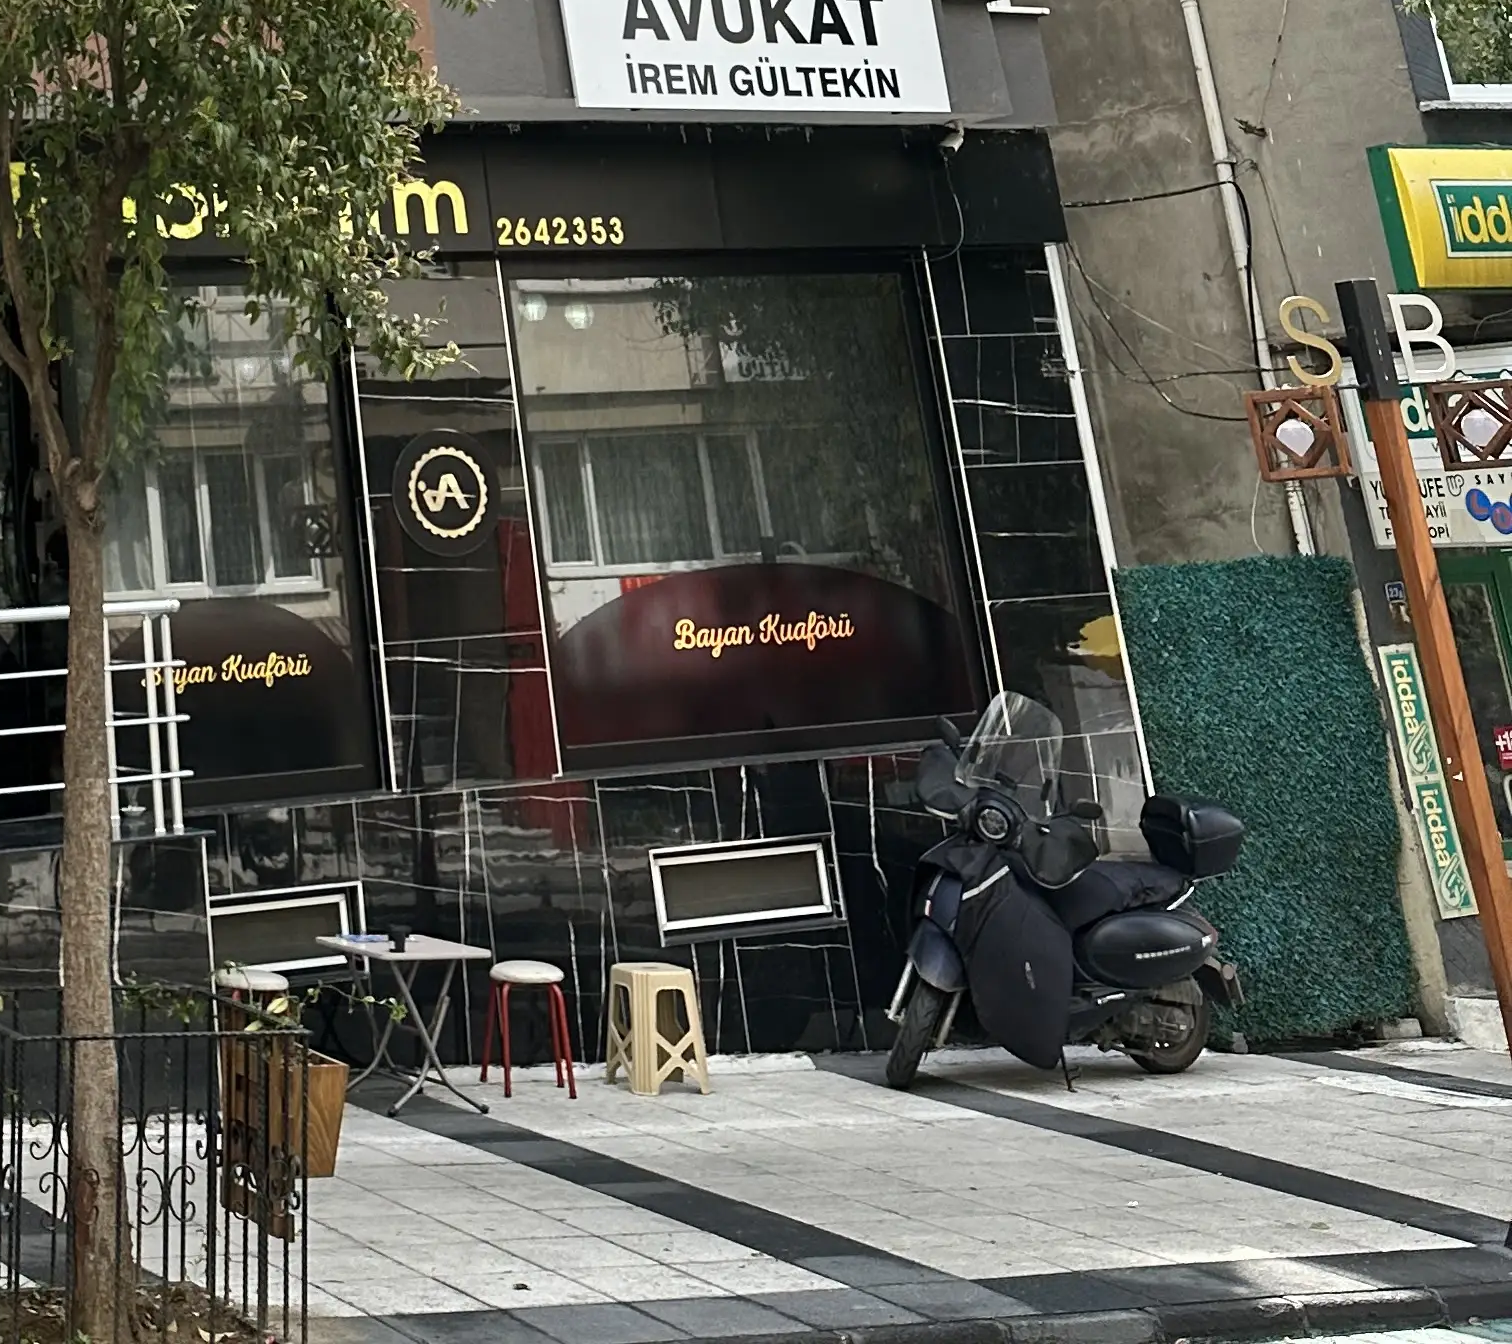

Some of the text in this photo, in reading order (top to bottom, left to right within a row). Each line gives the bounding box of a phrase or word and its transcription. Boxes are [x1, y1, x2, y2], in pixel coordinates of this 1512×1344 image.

[626, 53, 900, 98] İREM GÜLTEKİN
[497, 217, 624, 245] 2642353
[1279, 293, 1456, 386] S B
[1475, 472, 1512, 485] SAY
[674, 611, 854, 658] Bayan Kuaförü
[221, 652, 311, 688] Kuaförü
[1391, 658, 1421, 736] iddaa
[1421, 789, 1452, 868] iddaa
